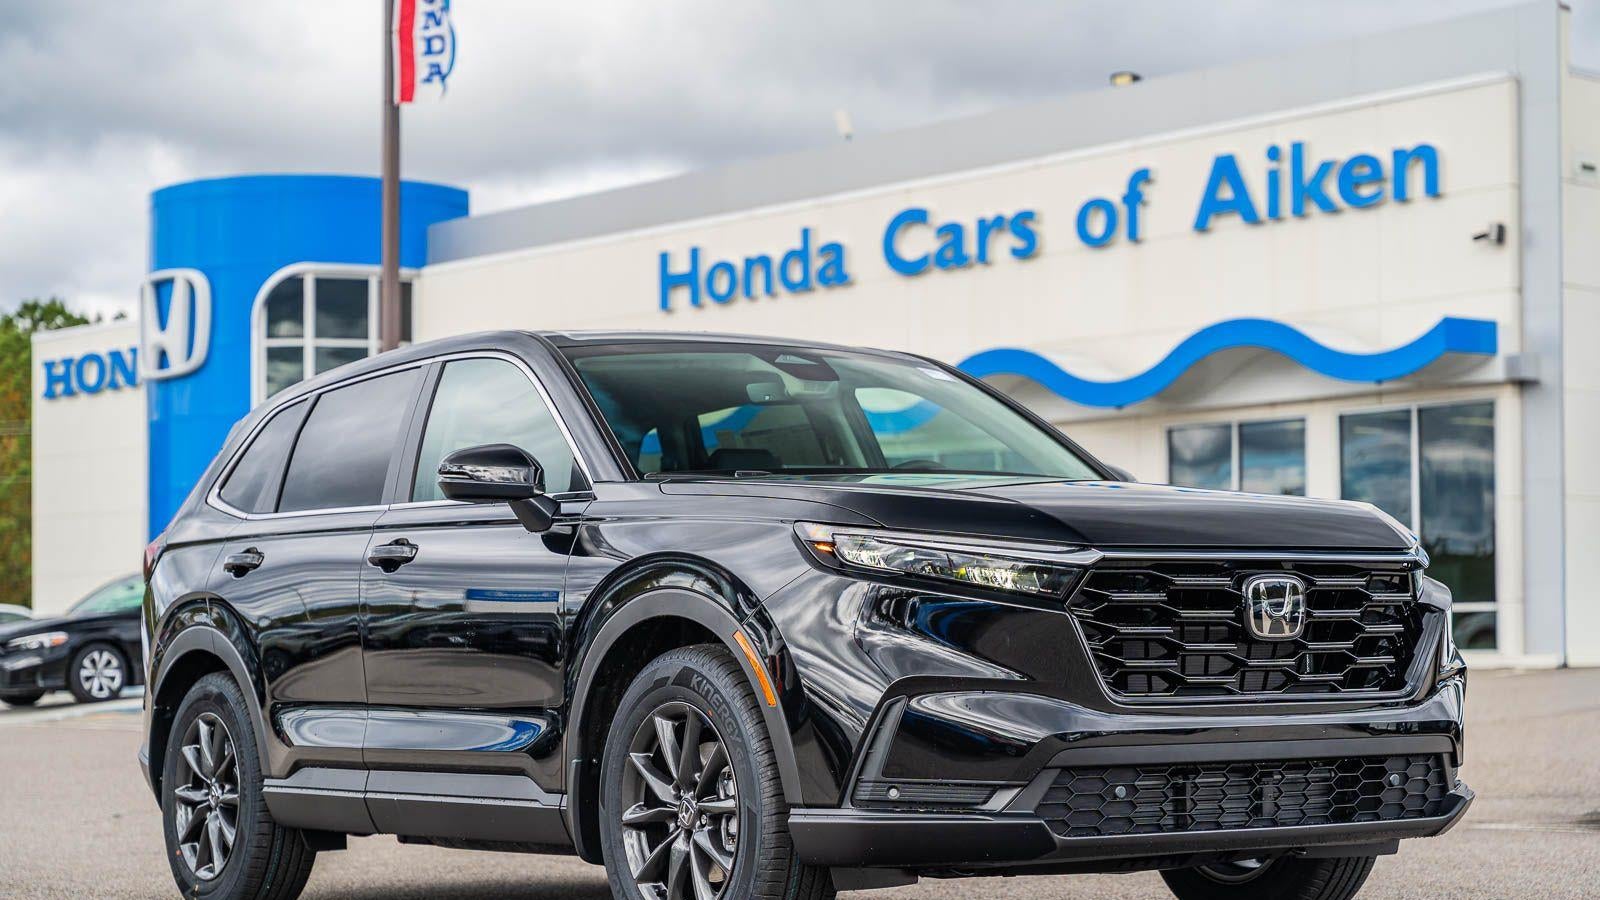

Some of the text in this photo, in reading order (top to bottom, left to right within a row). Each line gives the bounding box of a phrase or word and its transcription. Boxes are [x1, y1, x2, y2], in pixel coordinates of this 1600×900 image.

[423, 0, 446, 83] NDA
[660, 141, 1438, 311] Honda Cars of Aiken
